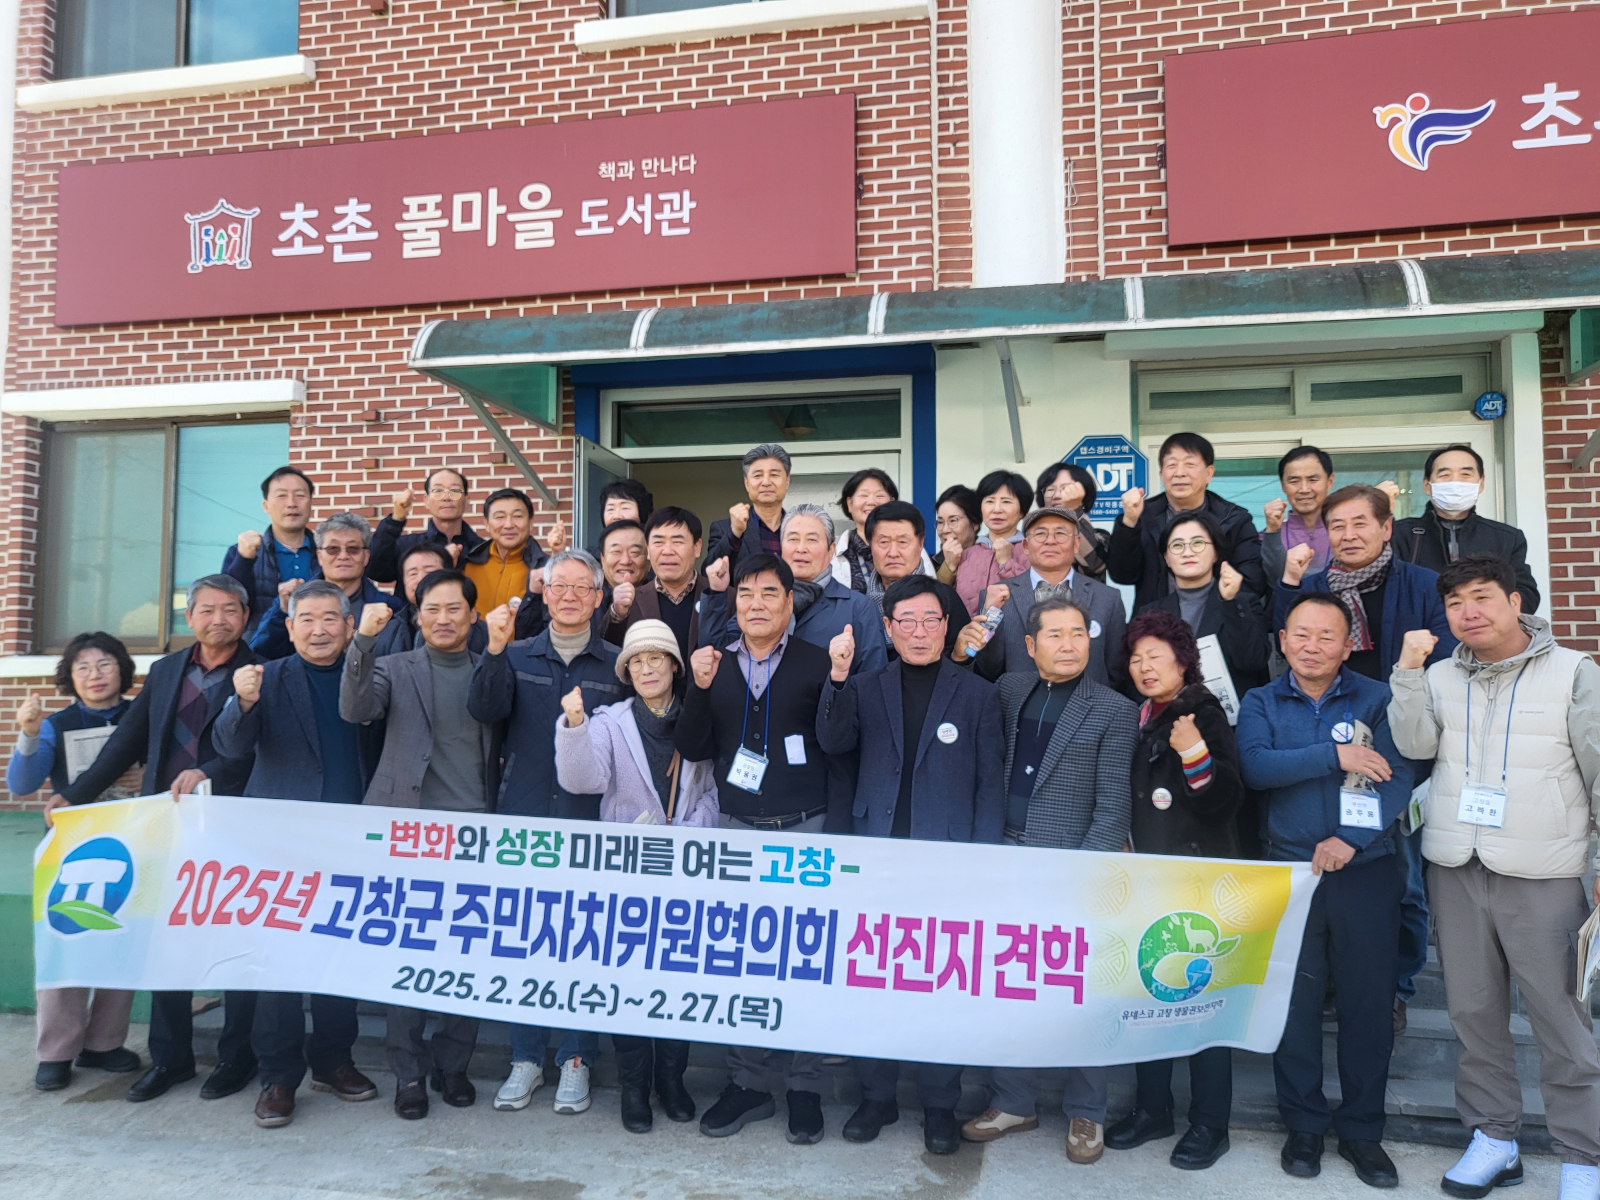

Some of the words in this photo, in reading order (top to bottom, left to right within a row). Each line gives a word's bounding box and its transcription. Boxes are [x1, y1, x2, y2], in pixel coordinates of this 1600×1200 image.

[1511, 82, 1600, 150] 초
[598, 159, 636, 182] 책과
[641, 153, 698, 179] 만나다
[271, 197, 380, 264] 초촌
[394, 182, 564, 260] 풀마을
[574, 189, 698, 238] 도서관
[1481, 400, 1502, 410] ADT
[496, 827, 565, 869] 성장
[569, 832, 675, 877] 미래를
[682, 839, 754, 883] 여는
[168, 858, 322, 932] 2025년
[309, 873, 446, 952] 고창군
[448, 882, 840, 986] 주민자치위원협의회
[846, 912, 985, 998] 선진지
[993, 922, 1090, 1006] 견학
[1156, 1008, 1173, 1019] 고창
